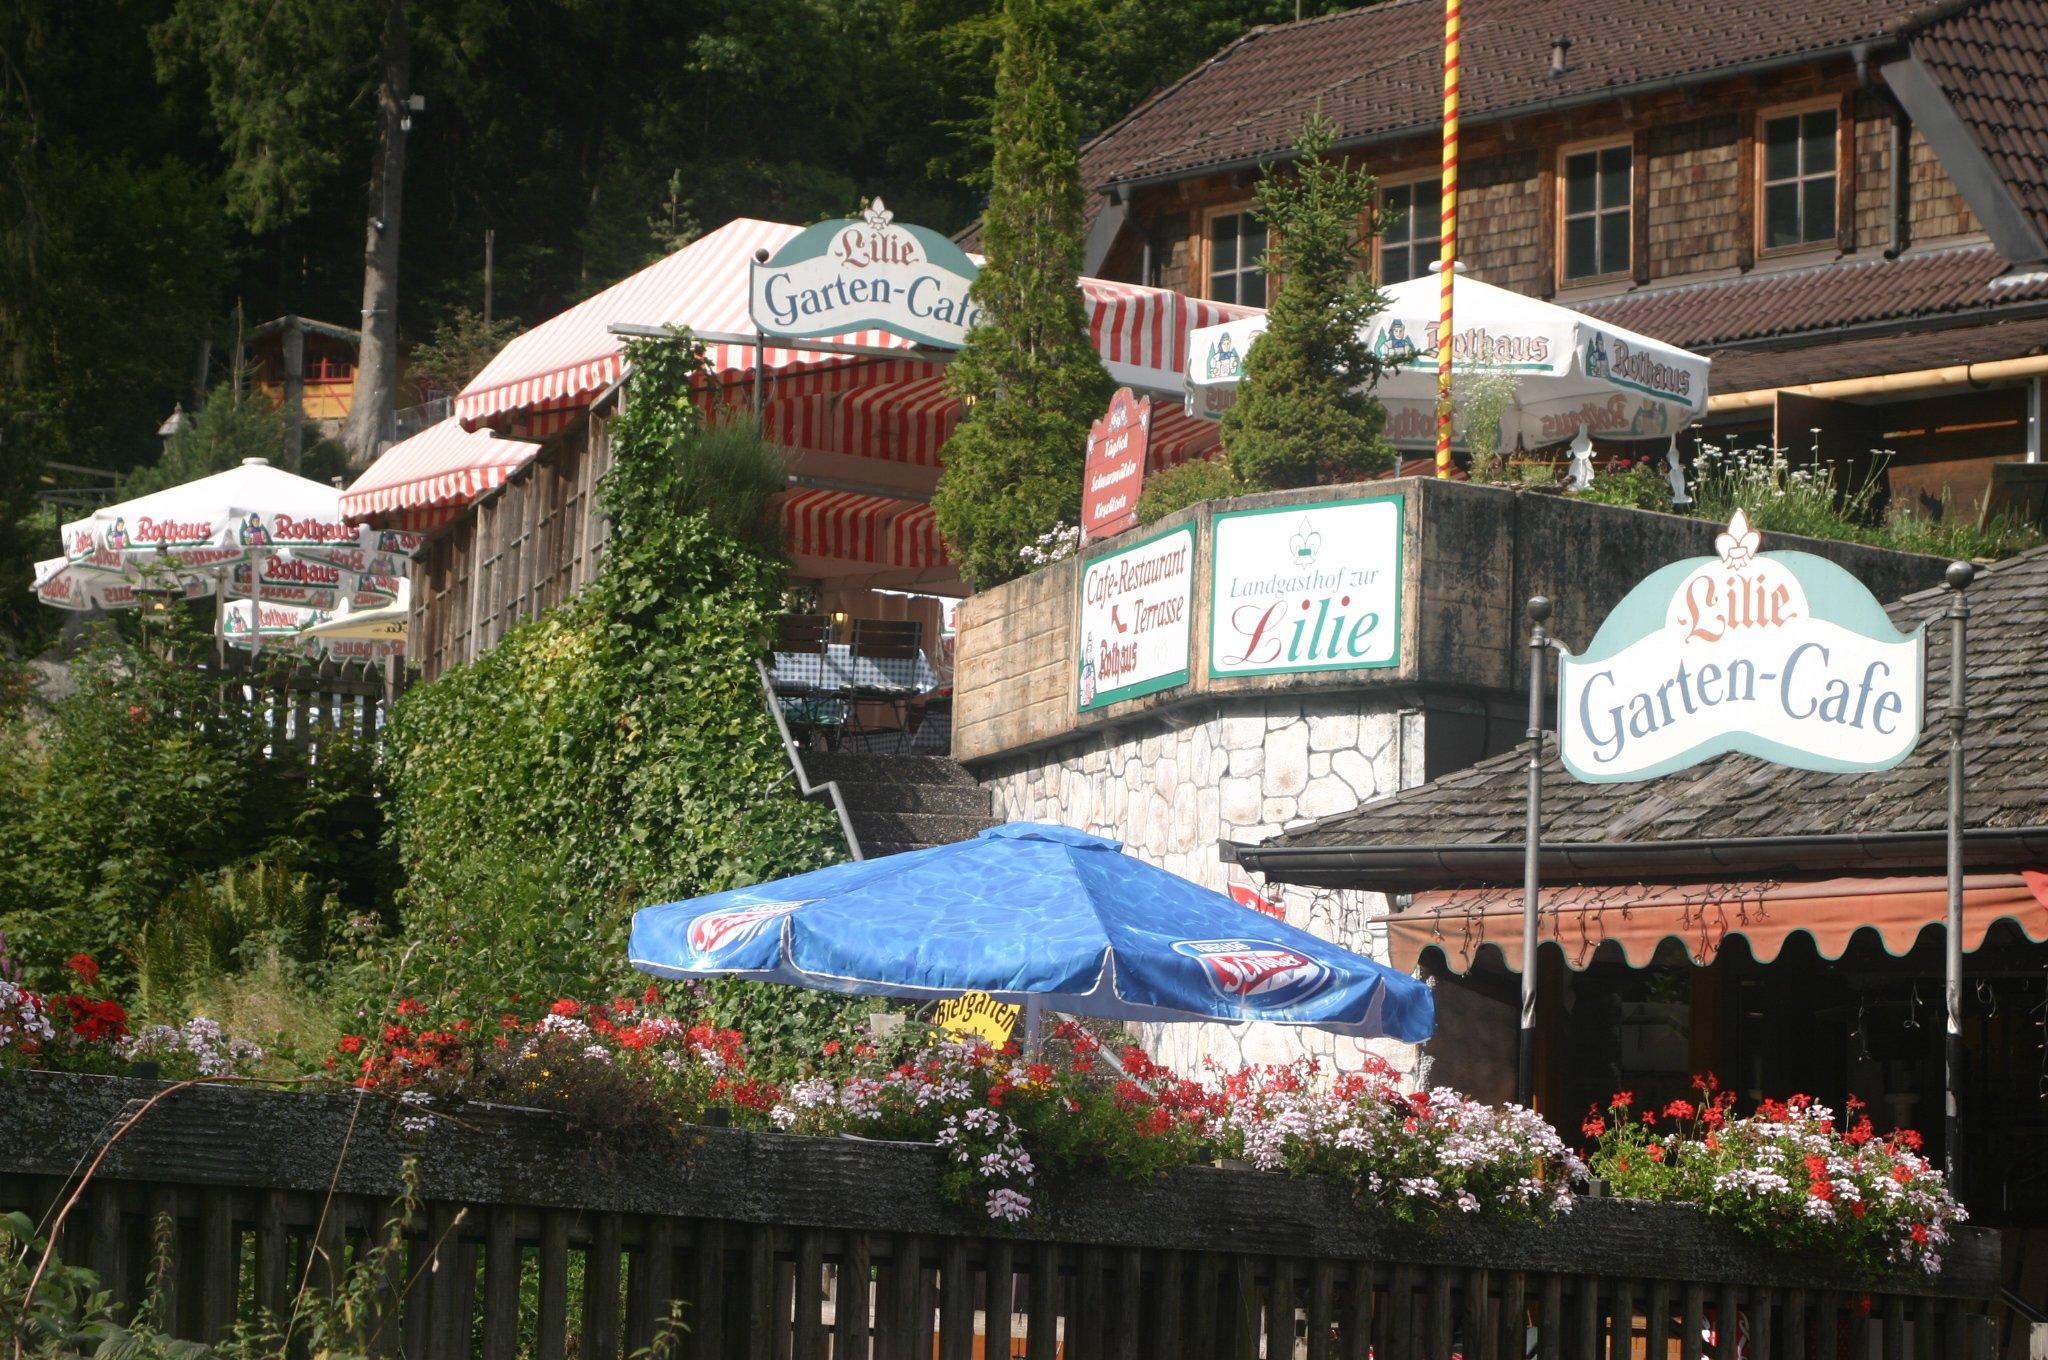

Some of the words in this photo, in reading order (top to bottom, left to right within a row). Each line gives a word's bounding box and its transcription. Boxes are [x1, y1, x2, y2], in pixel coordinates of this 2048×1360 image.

[834, 228, 920, 268] Lilie
[764, 272, 983, 328] Garten-Cafe
[1612, 338, 1691, 396] Rothaus
[134, 516, 212, 542] Rothaus
[273, 513, 360, 543] Rothaus
[264, 555, 340, 585] Rothaus
[1087, 541, 1187, 609] Cafe-Restaurant
[1230, 567, 1346, 599] Landgasthof
[1349, 567, 1380, 589] zur
[1133, 594, 1185, 635] Terrasse
[1677, 573, 1798, 644] Lilie
[1221, 595, 1380, 666] Lilie
[1098, 639, 1138, 685] Rothaus
[1579, 642, 1902, 763] Garten-Cafe
[936, 992, 1017, 1032] Biergarten
